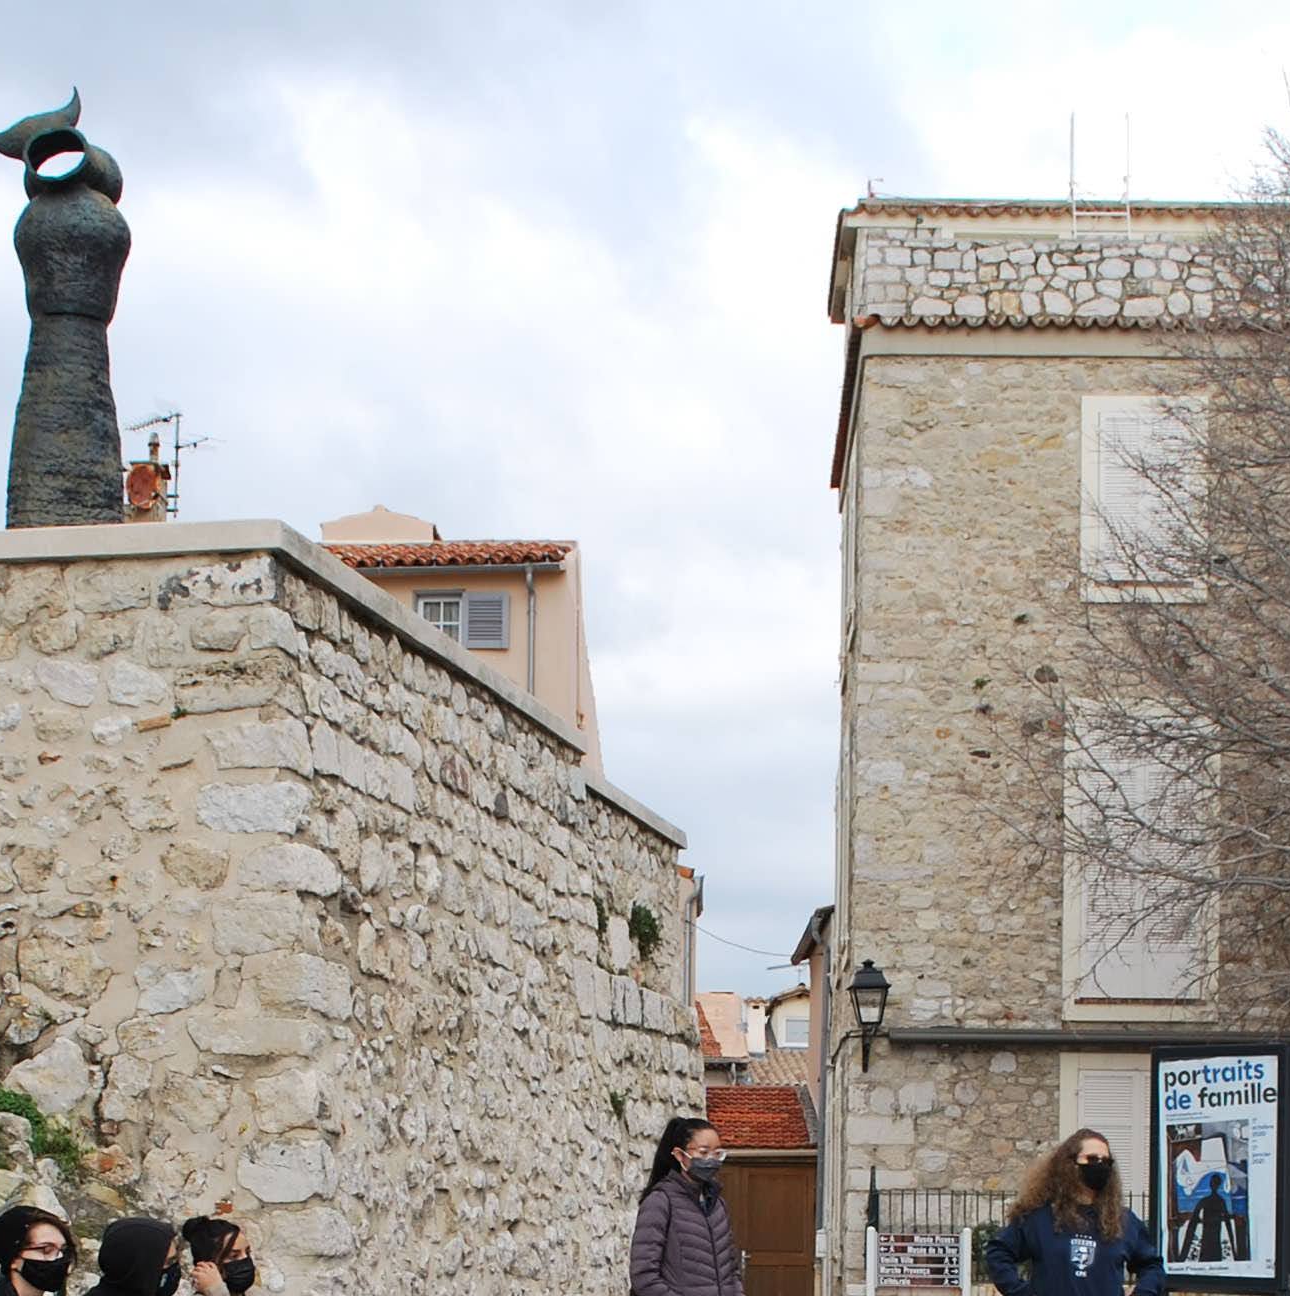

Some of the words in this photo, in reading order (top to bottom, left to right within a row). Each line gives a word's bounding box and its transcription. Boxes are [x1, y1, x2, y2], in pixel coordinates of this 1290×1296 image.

[1164, 1059, 1264, 1092] portraits
[1165, 1089, 1191, 1111] de
[1198, 1082, 1277, 1108] famille
